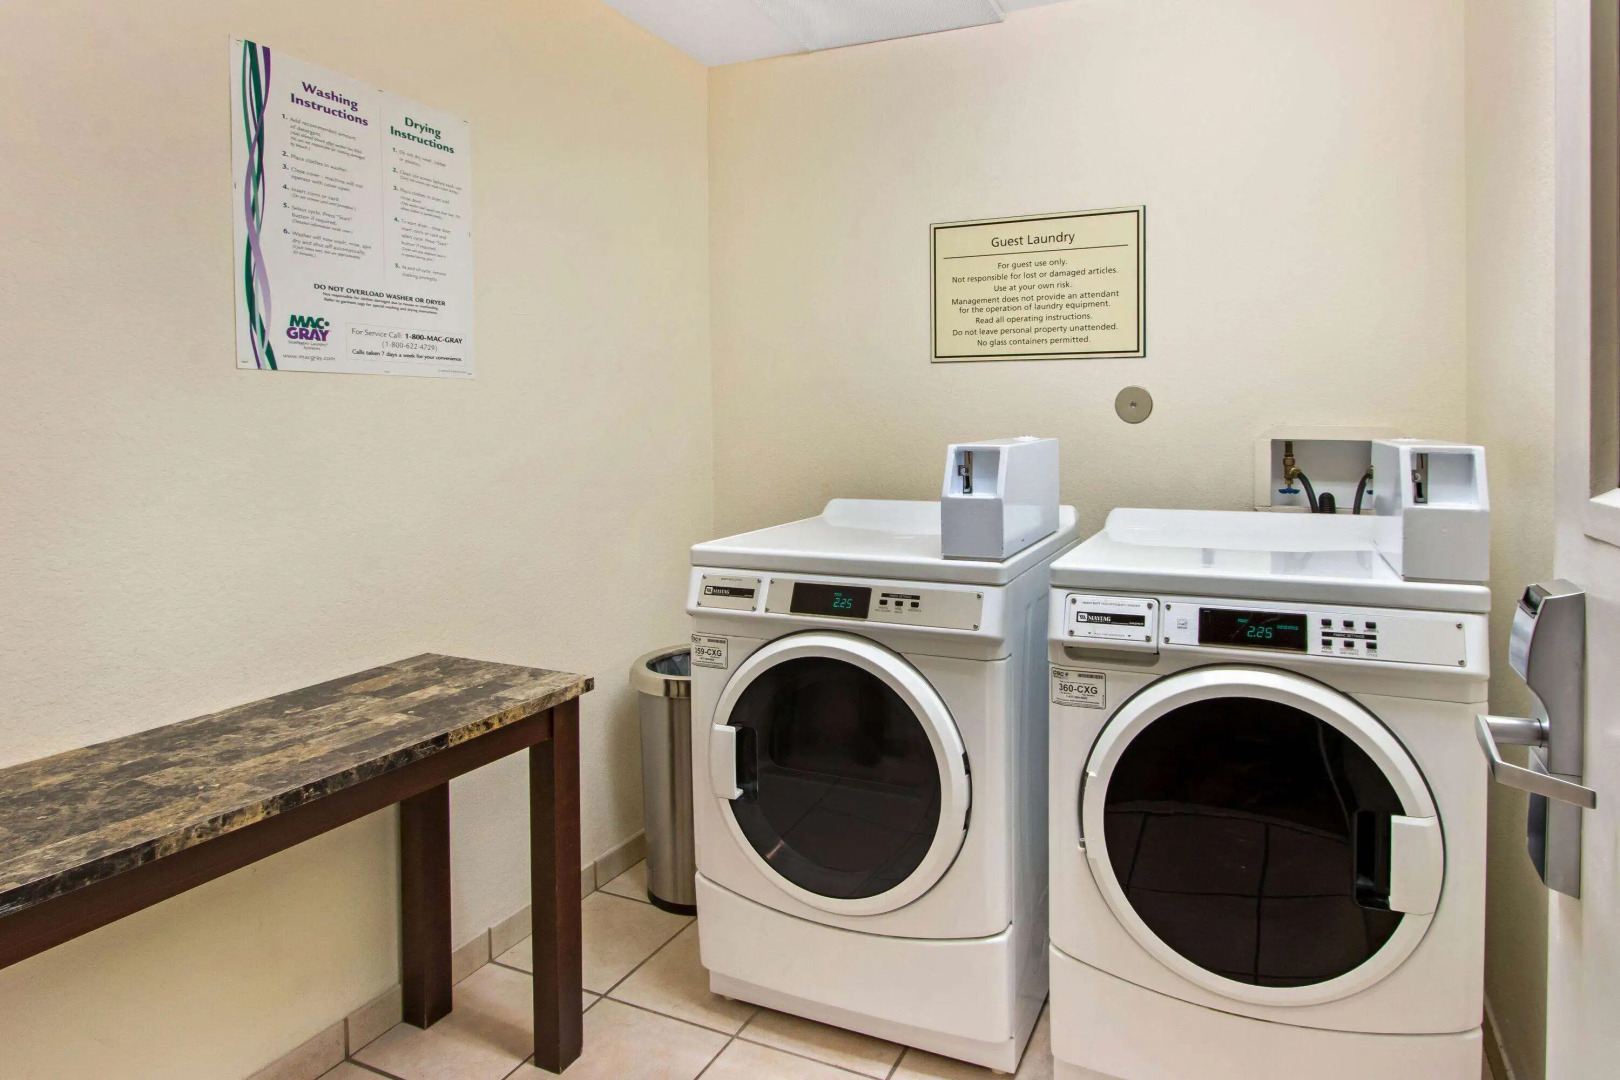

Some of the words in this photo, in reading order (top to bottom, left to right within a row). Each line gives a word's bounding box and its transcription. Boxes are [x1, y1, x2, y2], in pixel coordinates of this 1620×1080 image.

[302, 81, 358, 112] Washing
[290, 93, 368, 126] Instructions
[405, 117, 441, 139] Drying
[390, 126, 454, 153] Instructions
[991, 235, 1023, 248] Guest
[1028, 232, 1075, 244] Laundry
[1012, 260, 1032, 269] guest
[1049, 259, 1067, 267] only.
[967, 274, 1008, 283] responsible
[1050, 267, 1086, 278] damaged
[1088, 267, 1118, 275] articles.
[346, 288, 385, 298] OVERLOAD
[1018, 283, 1035, 292] your
[951, 296, 1000, 306] Management
[1002, 295, 1019, 303] does
[1036, 293, 1066, 302] provide
[1080, 290, 1119, 299] attendant
[986, 304, 1021, 313] operation
[1024, 303, 1032, 311] of
[1034, 302, 1062, 311] laundry
[1065, 300, 1111, 310] equipment.
[1007, 314, 1043, 324] operating
[1045, 313, 1092, 321] instructions.
[286, 327, 329, 341] GRAY
[979, 327, 998, 335] leave
[1000, 326, 1032, 335] personal
[1034, 325, 1067, 334] property
[1069, 323, 1118, 332] unattended.
[405, 333, 462, 344] 1-800-MAC-GRAY
[989, 338, 1007, 347] glass
[1009, 337, 1048, 345] containers
[1050, 336, 1091, 344] permitted.
[382, 341, 438, 352] (1-800-622-4729)
[833, 598, 853, 609] 2.25
[1247, 626, 1272, 638] 2.25
